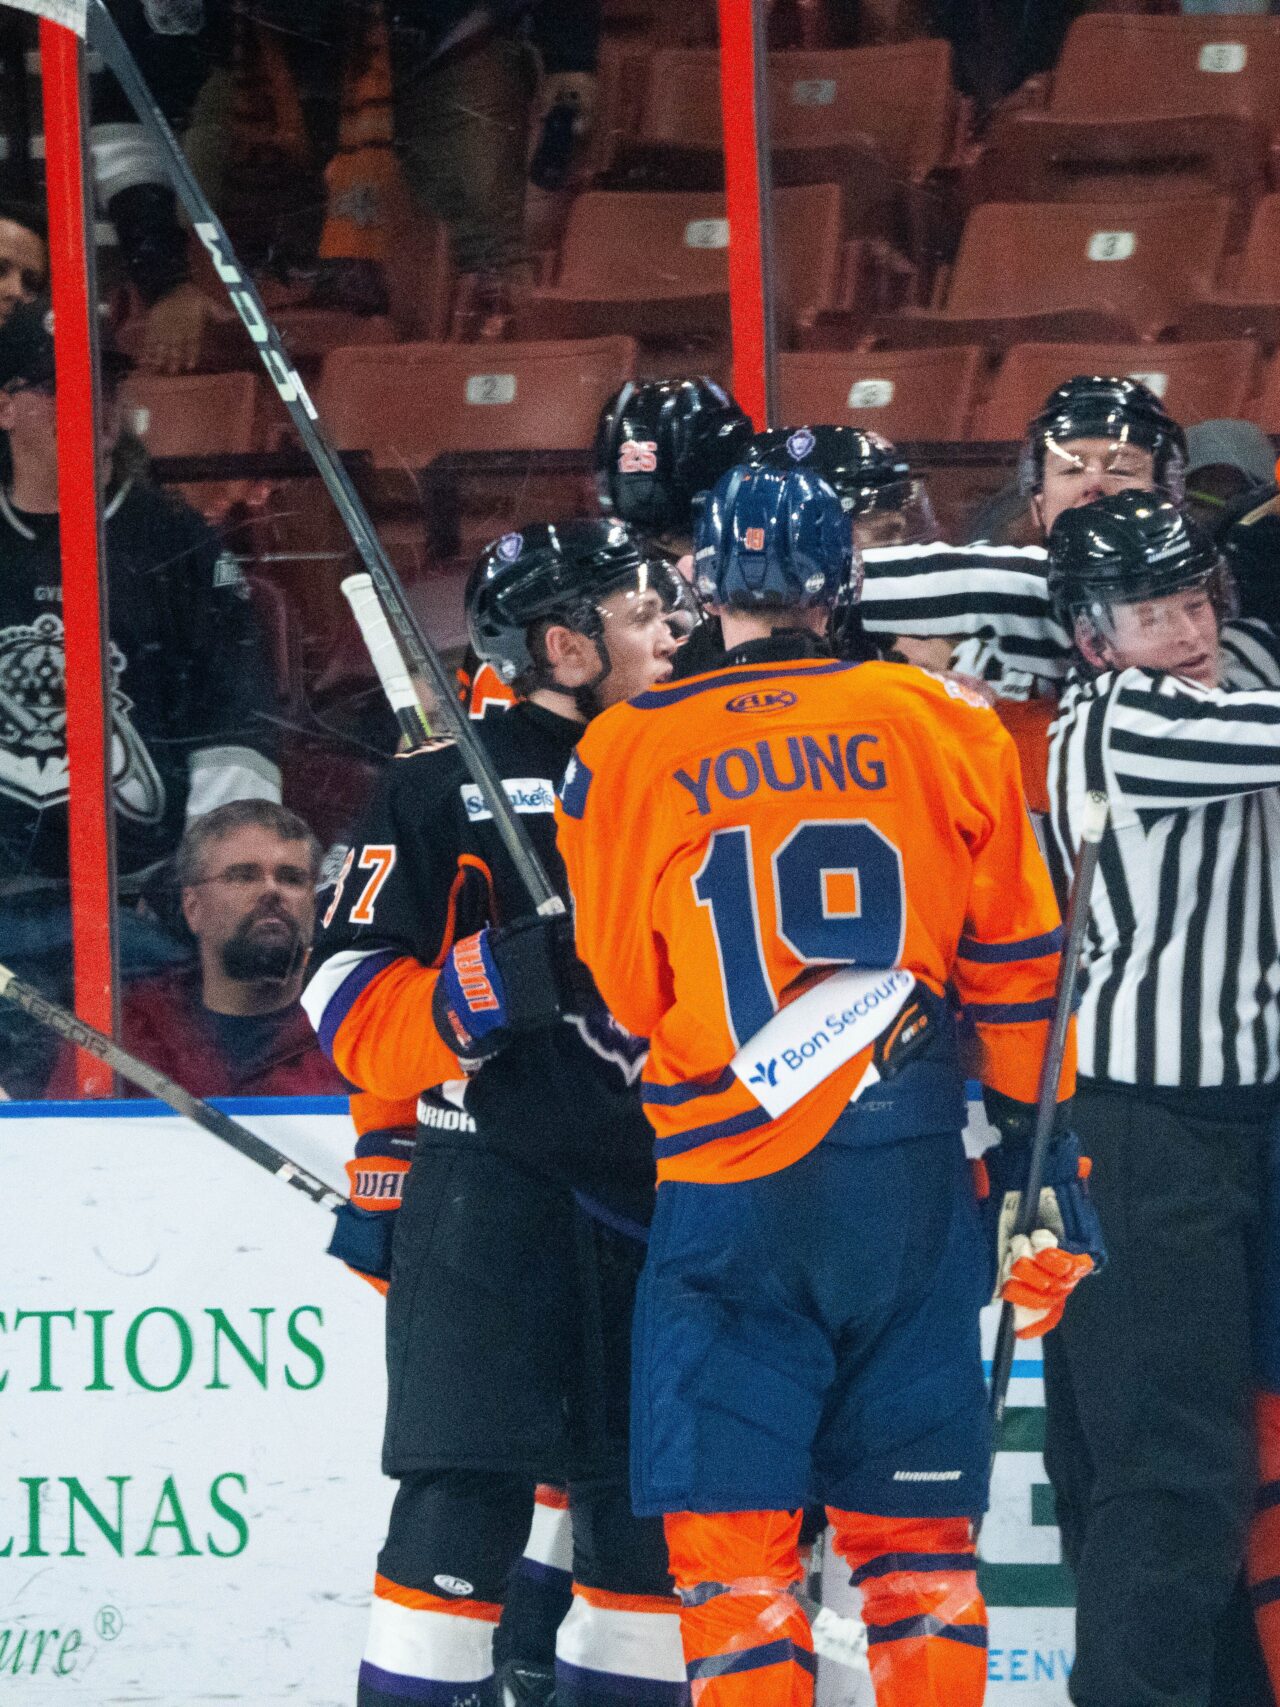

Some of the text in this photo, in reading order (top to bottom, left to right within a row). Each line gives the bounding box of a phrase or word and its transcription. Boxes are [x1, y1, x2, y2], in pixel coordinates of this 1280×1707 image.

[195, 222, 296, 403] CCM
[673, 733, 888, 817] YOUNG
[690, 818, 907, 1052] 19
[781, 1030, 831, 1071] Bon
[825, 970, 911, 1037] Secours
[0, 1305, 325, 1392] TIONS
[0, 1472, 250, 1558] INAS
